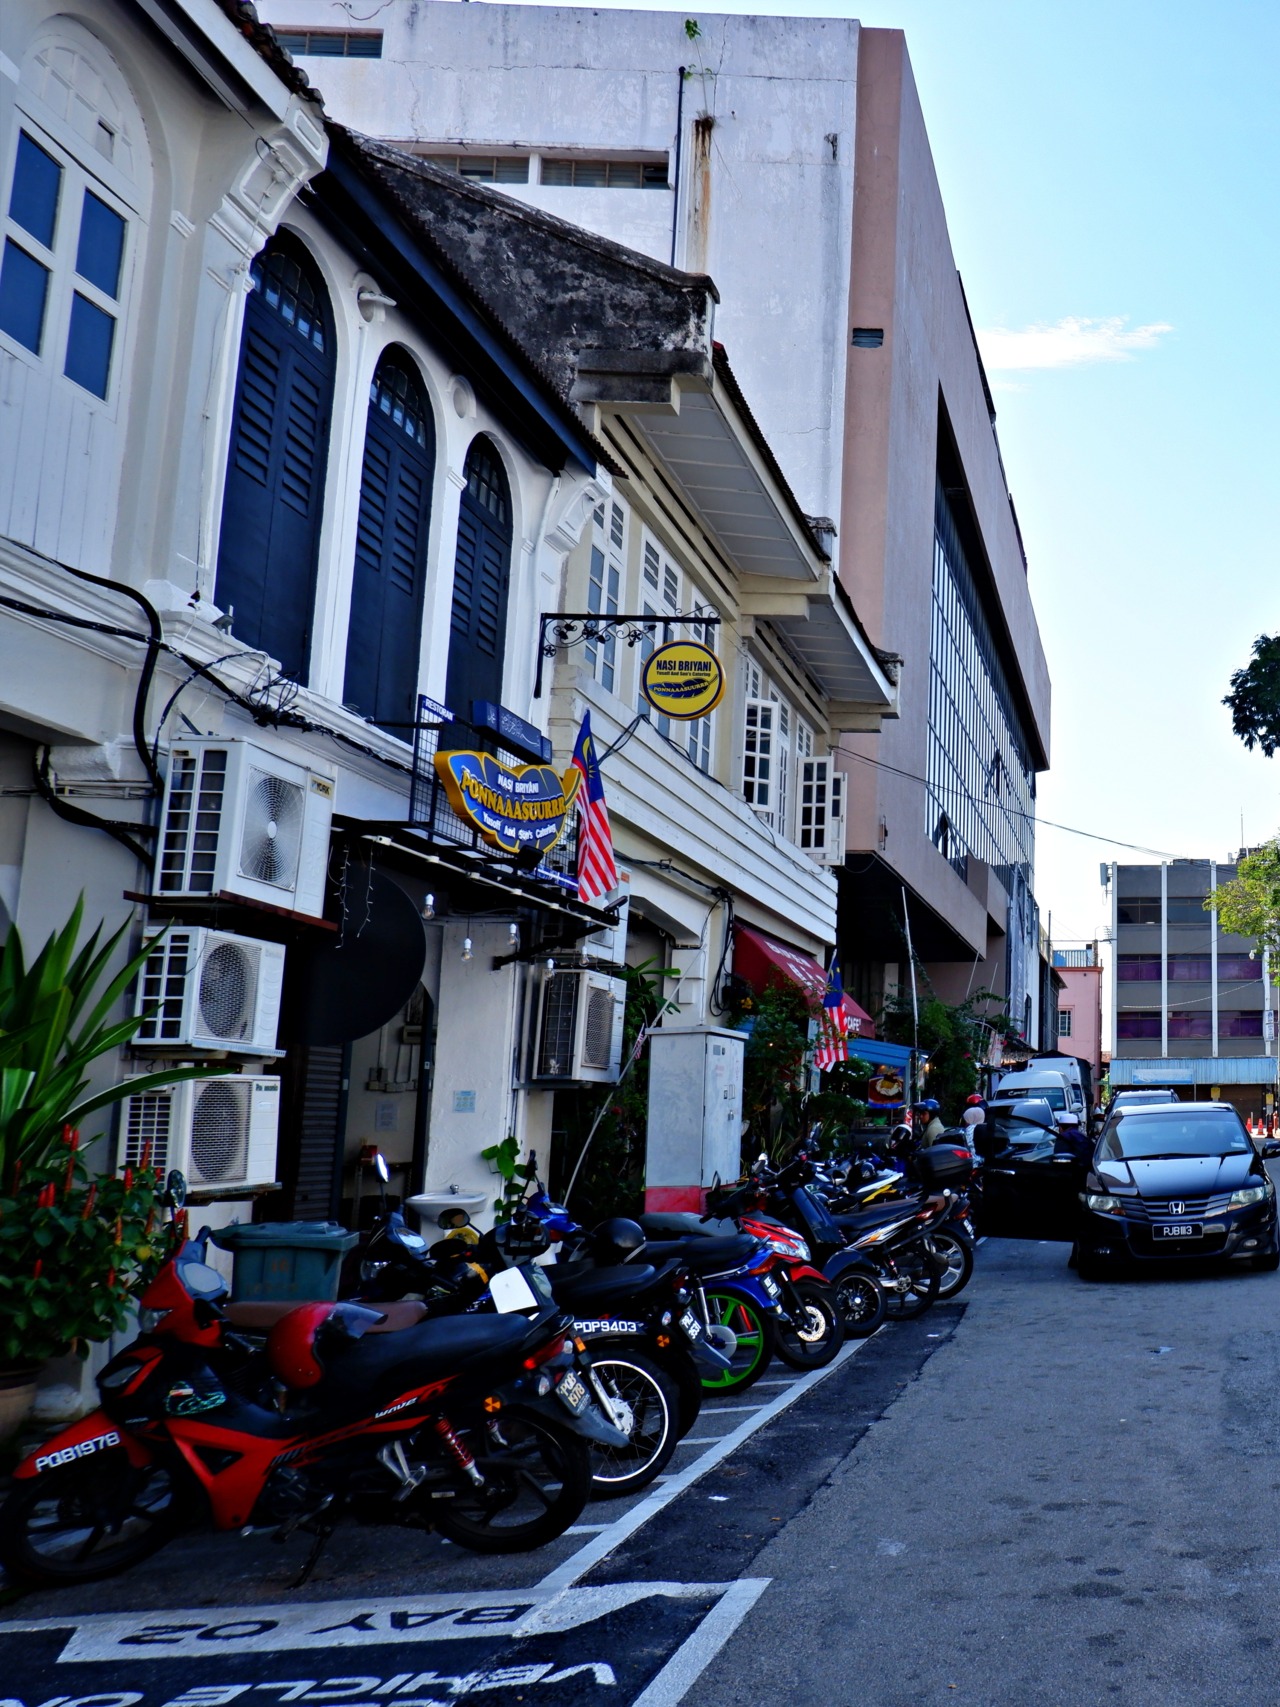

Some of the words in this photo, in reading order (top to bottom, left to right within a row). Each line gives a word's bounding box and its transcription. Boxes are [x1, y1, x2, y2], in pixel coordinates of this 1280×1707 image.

[656, 660, 677, 671] NASI
[678, 660, 711, 672] BRIYANI
[461, 768, 566, 821] PONNAAASUURRR
[498, 773, 514, 793] NASI
[515, 781, 539, 794] BRIYANI
[482, 811, 502, 831] Yusoff
[504, 825, 516, 839] And
[535, 823, 557, 839] Catering
[573, 1321, 637, 1333] PDP9403
[560, 1372, 577, 1397] PQB
[568, 1383, 585, 1408] 1978
[35, 1431, 120, 1473] PQB1978
[306, 1603, 535, 1635] BAY
